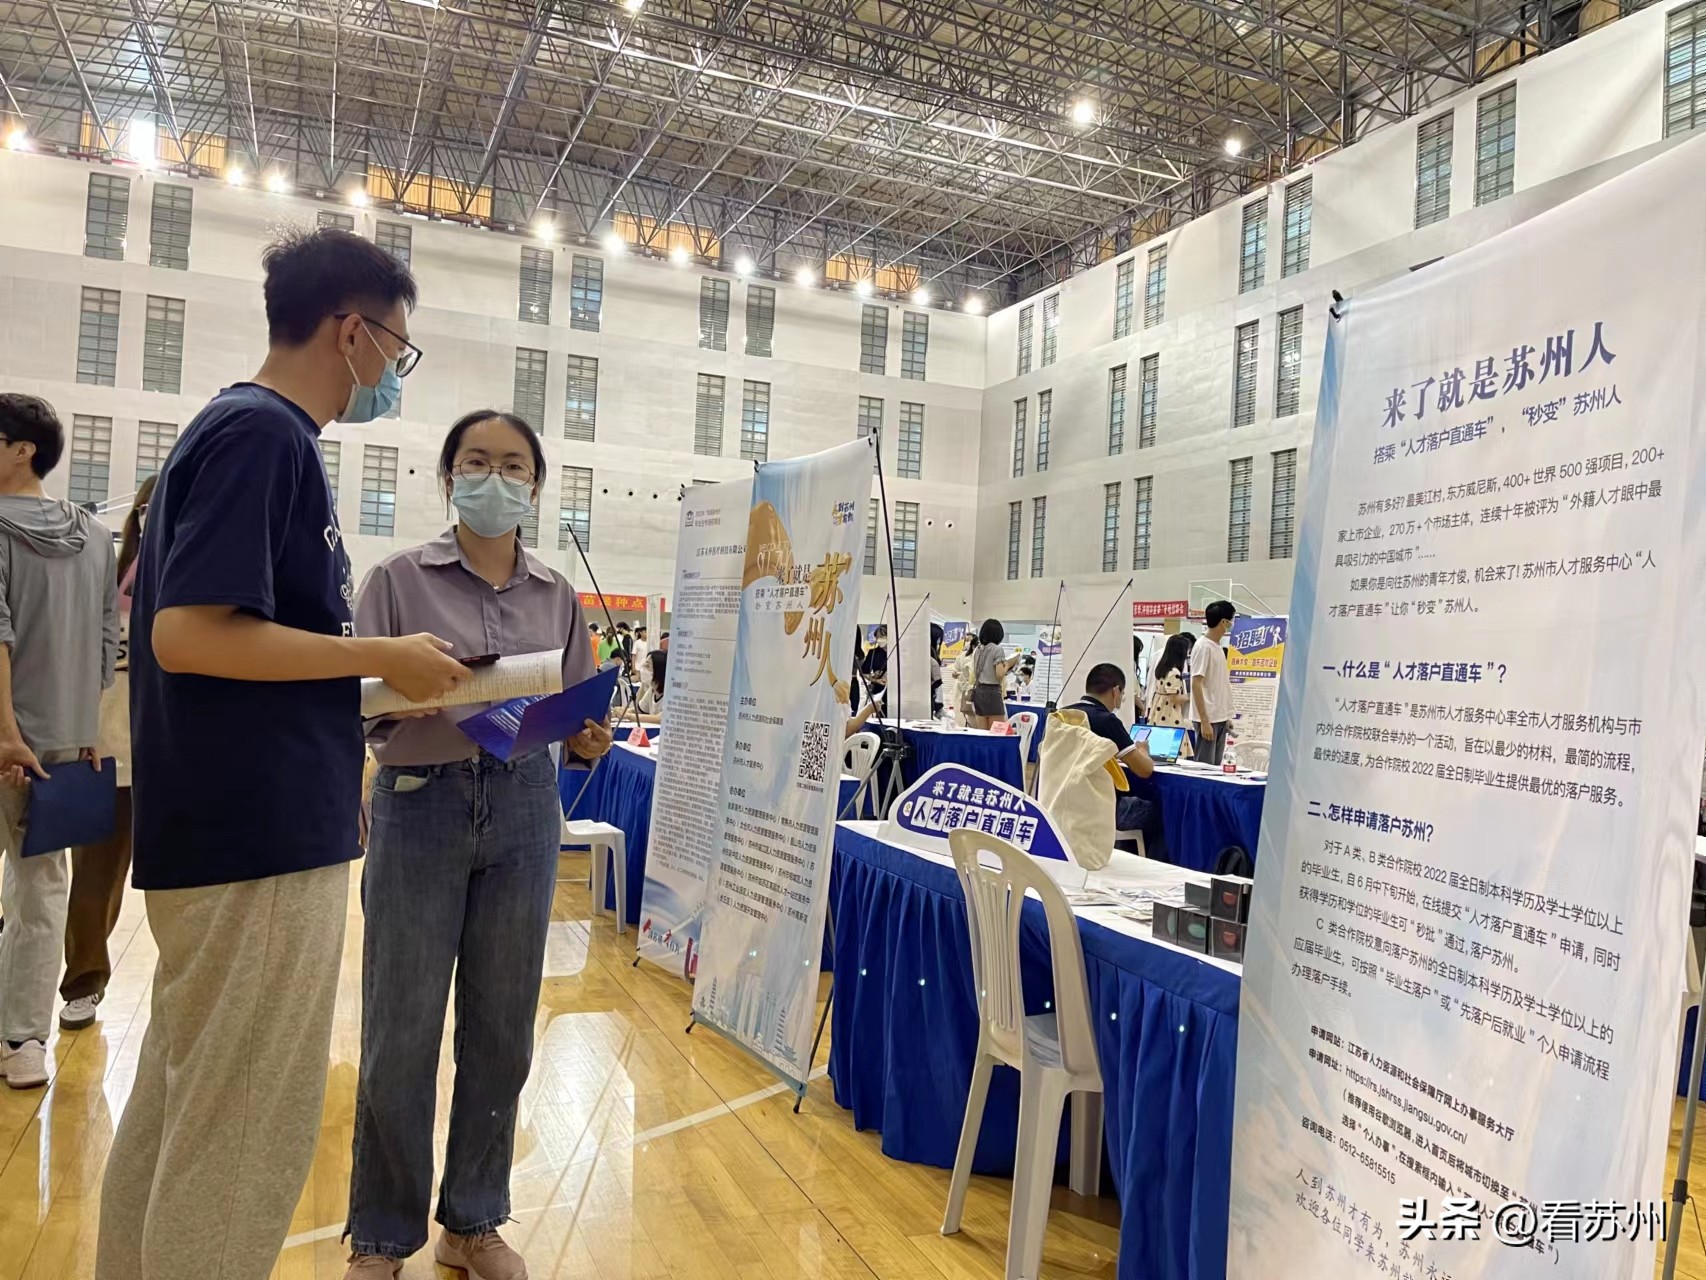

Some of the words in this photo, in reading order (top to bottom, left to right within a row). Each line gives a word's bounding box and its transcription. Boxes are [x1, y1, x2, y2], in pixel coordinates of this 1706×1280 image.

[1382, 321, 1617, 428] 来了就是苏州人
[932, 780, 1026, 812] 来了就是苏州人
[914, 800, 1035, 845] 人才落户直通车
[1307, 801, 1434, 842] 二、怎样申请落户苏州？
